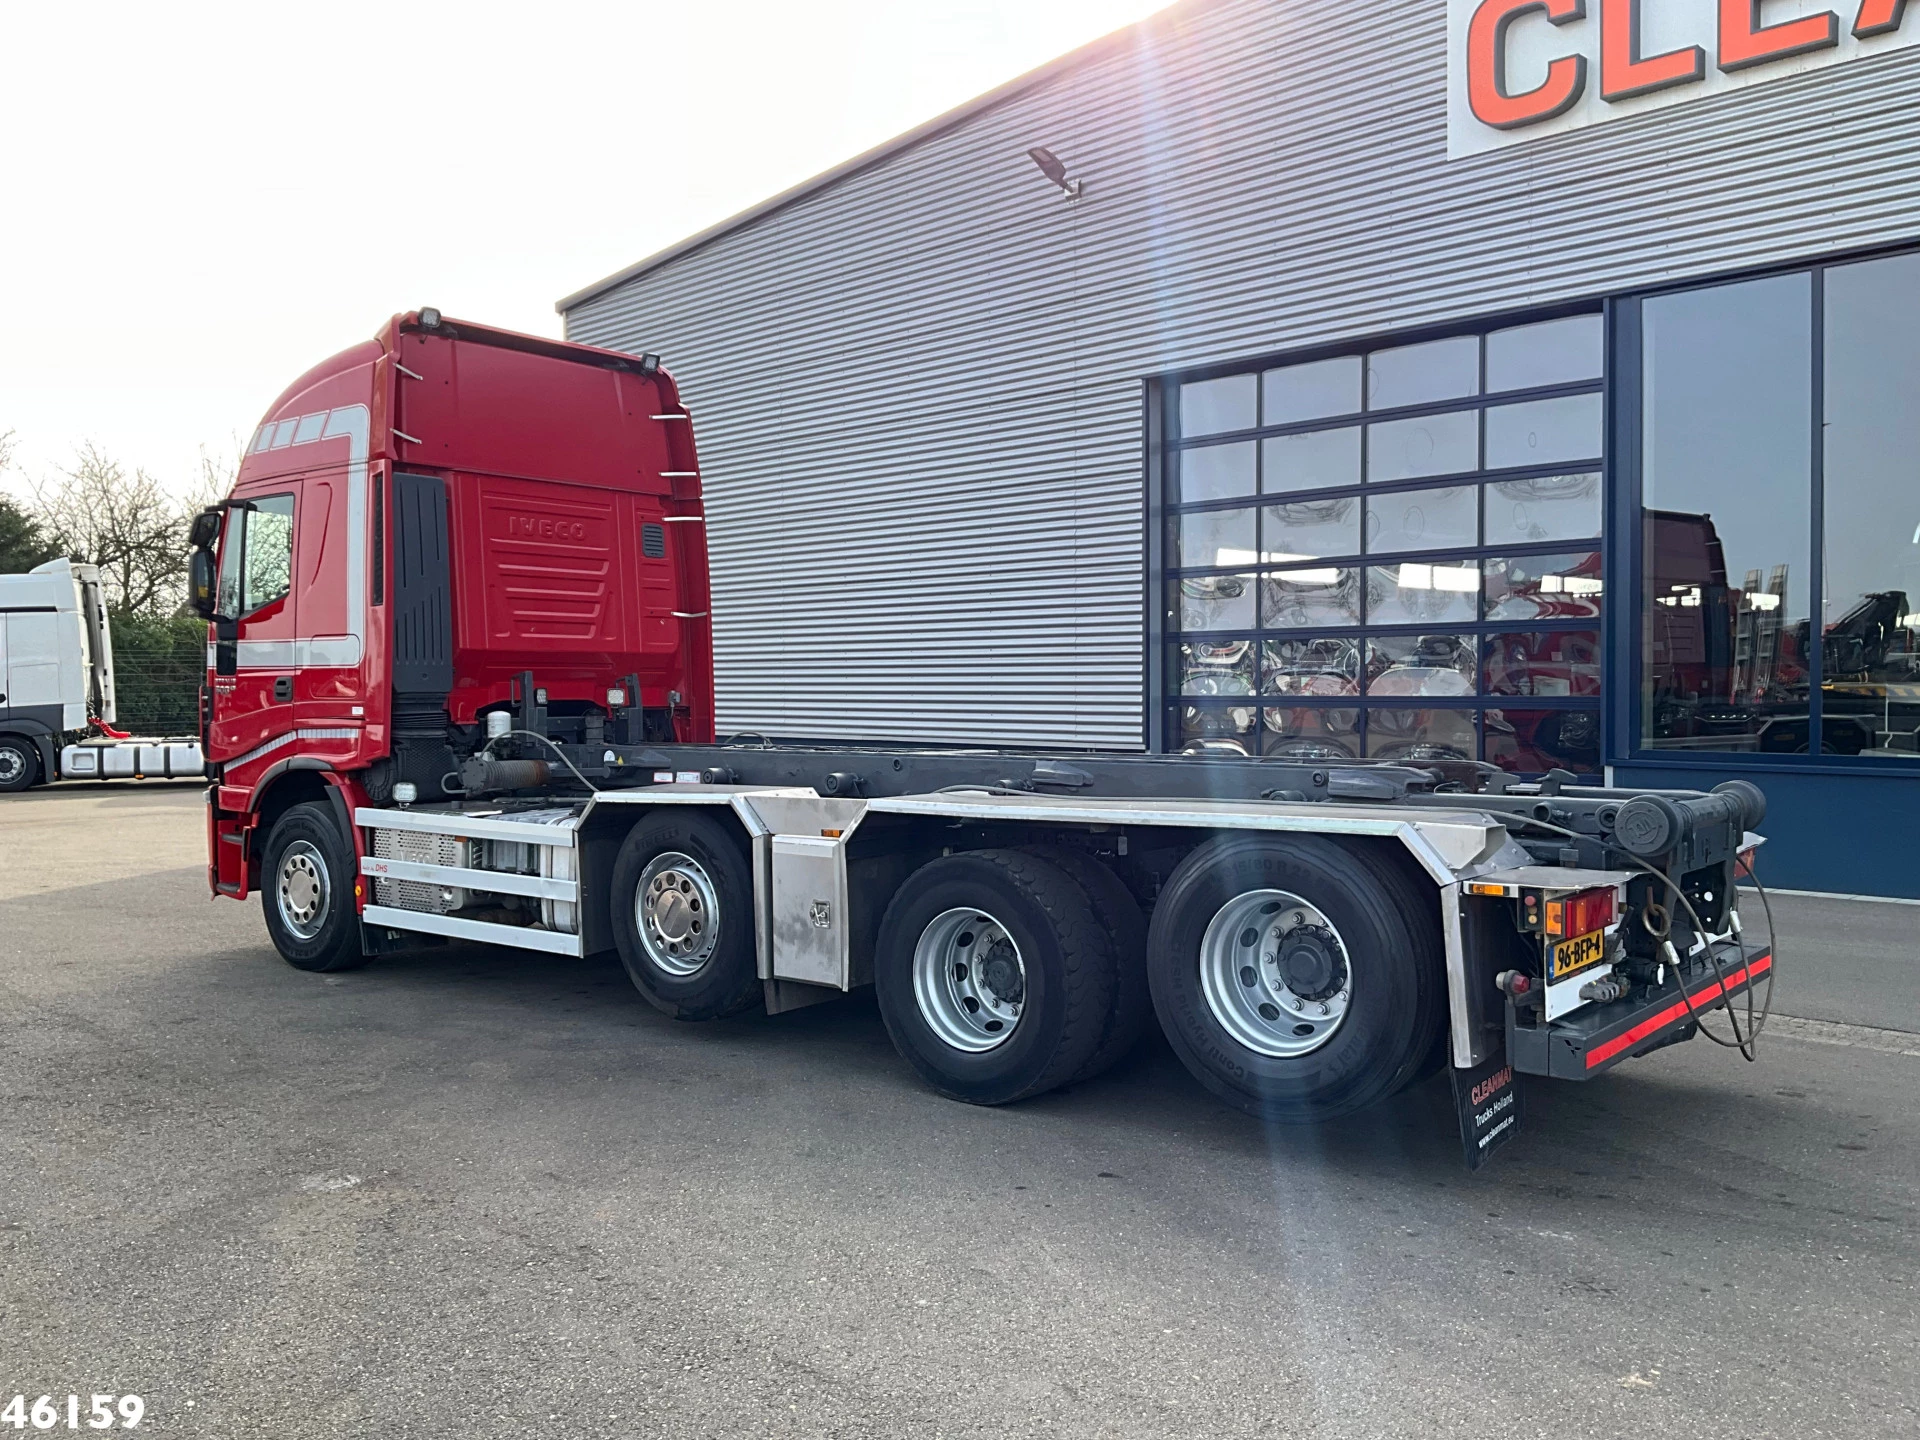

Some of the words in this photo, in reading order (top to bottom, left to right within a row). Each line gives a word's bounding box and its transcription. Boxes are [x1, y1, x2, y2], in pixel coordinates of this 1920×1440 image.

[1467, 0, 1908, 129] CL
[509, 516, 584, 541] IVECO
[375, 863, 388, 873] DHS
[1471, 1065, 1513, 1106] CLEANMAT
[1475, 1107, 1494, 1128] Trucks
[1493, 1090, 1514, 1114] Holland
